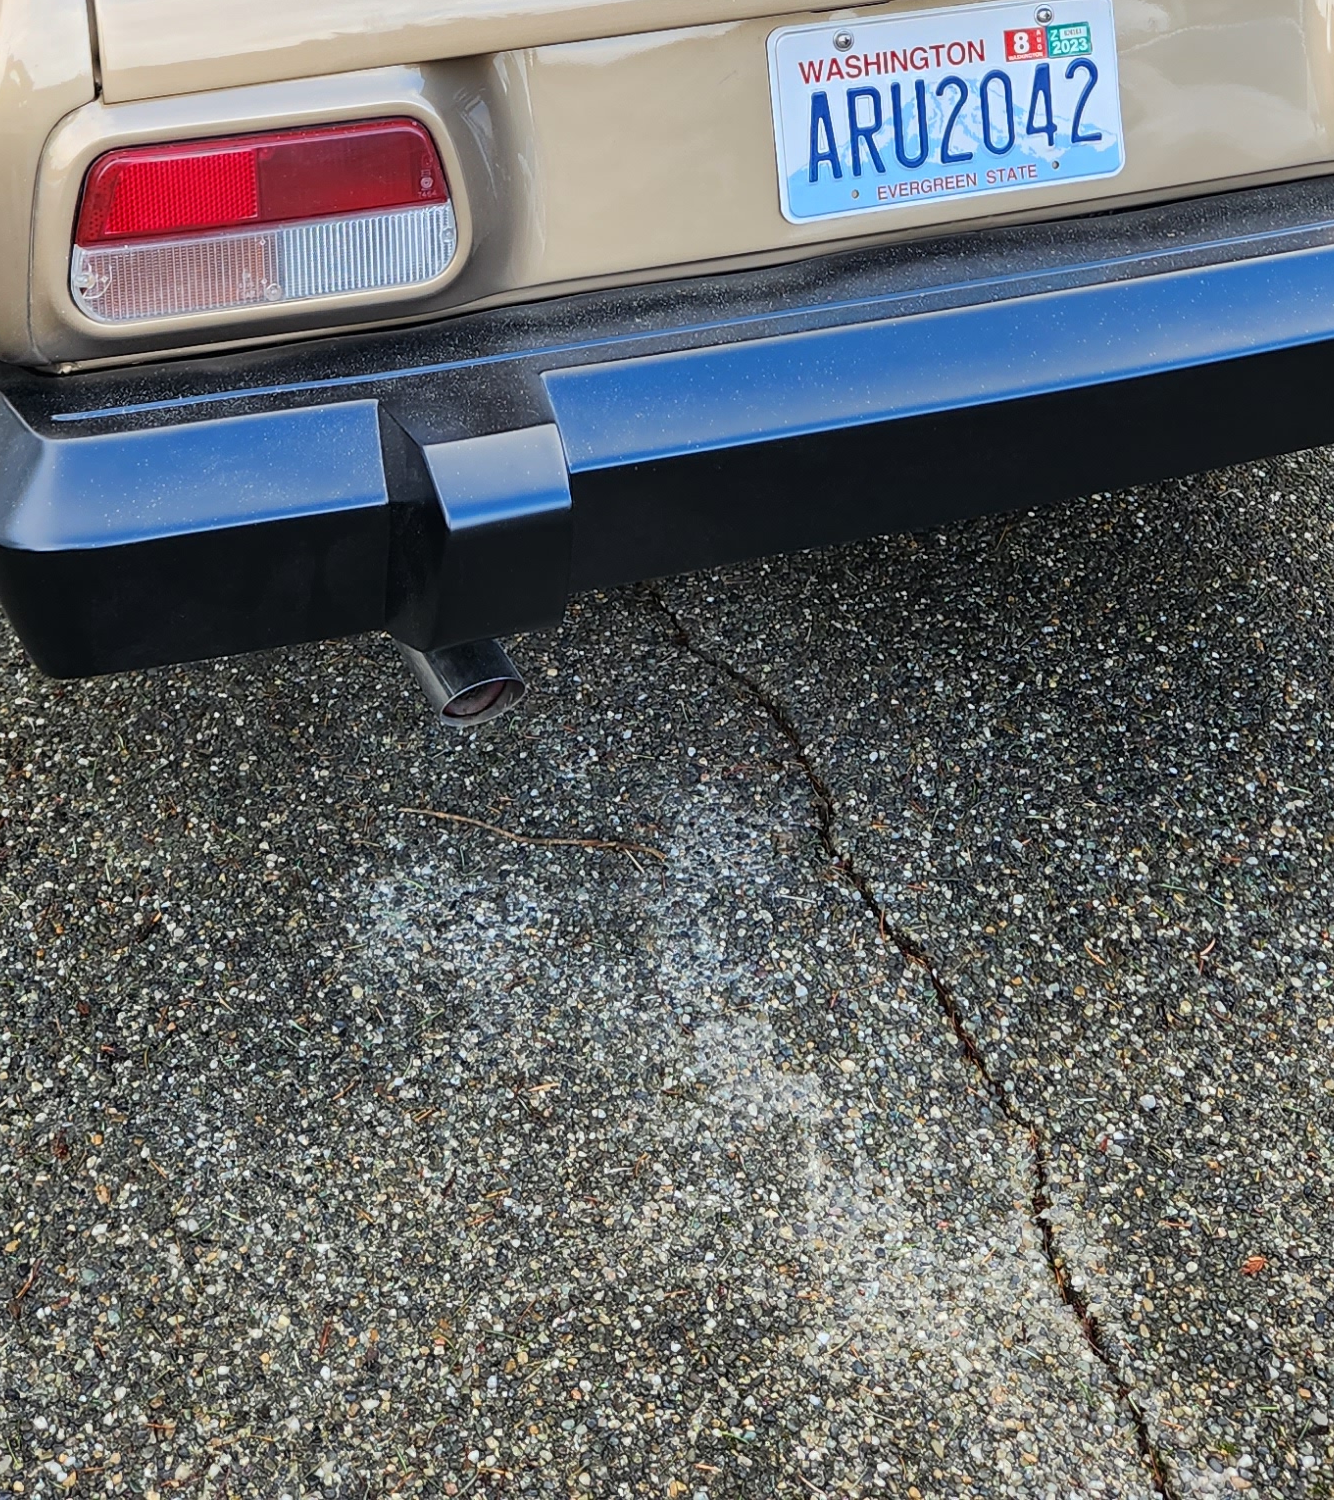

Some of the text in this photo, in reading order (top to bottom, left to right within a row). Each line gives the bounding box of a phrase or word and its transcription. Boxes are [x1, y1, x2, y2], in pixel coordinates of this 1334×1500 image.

[1013, 31, 1030, 54] 8
[1049, 29, 1059, 41] Z
[1051, 37, 1089, 55] 2023
[798, 38, 986, 85] WASHINGTON
[808, 57, 1104, 184] ARU2042
[876, 164, 1038, 201] EVERGREEN STATE
